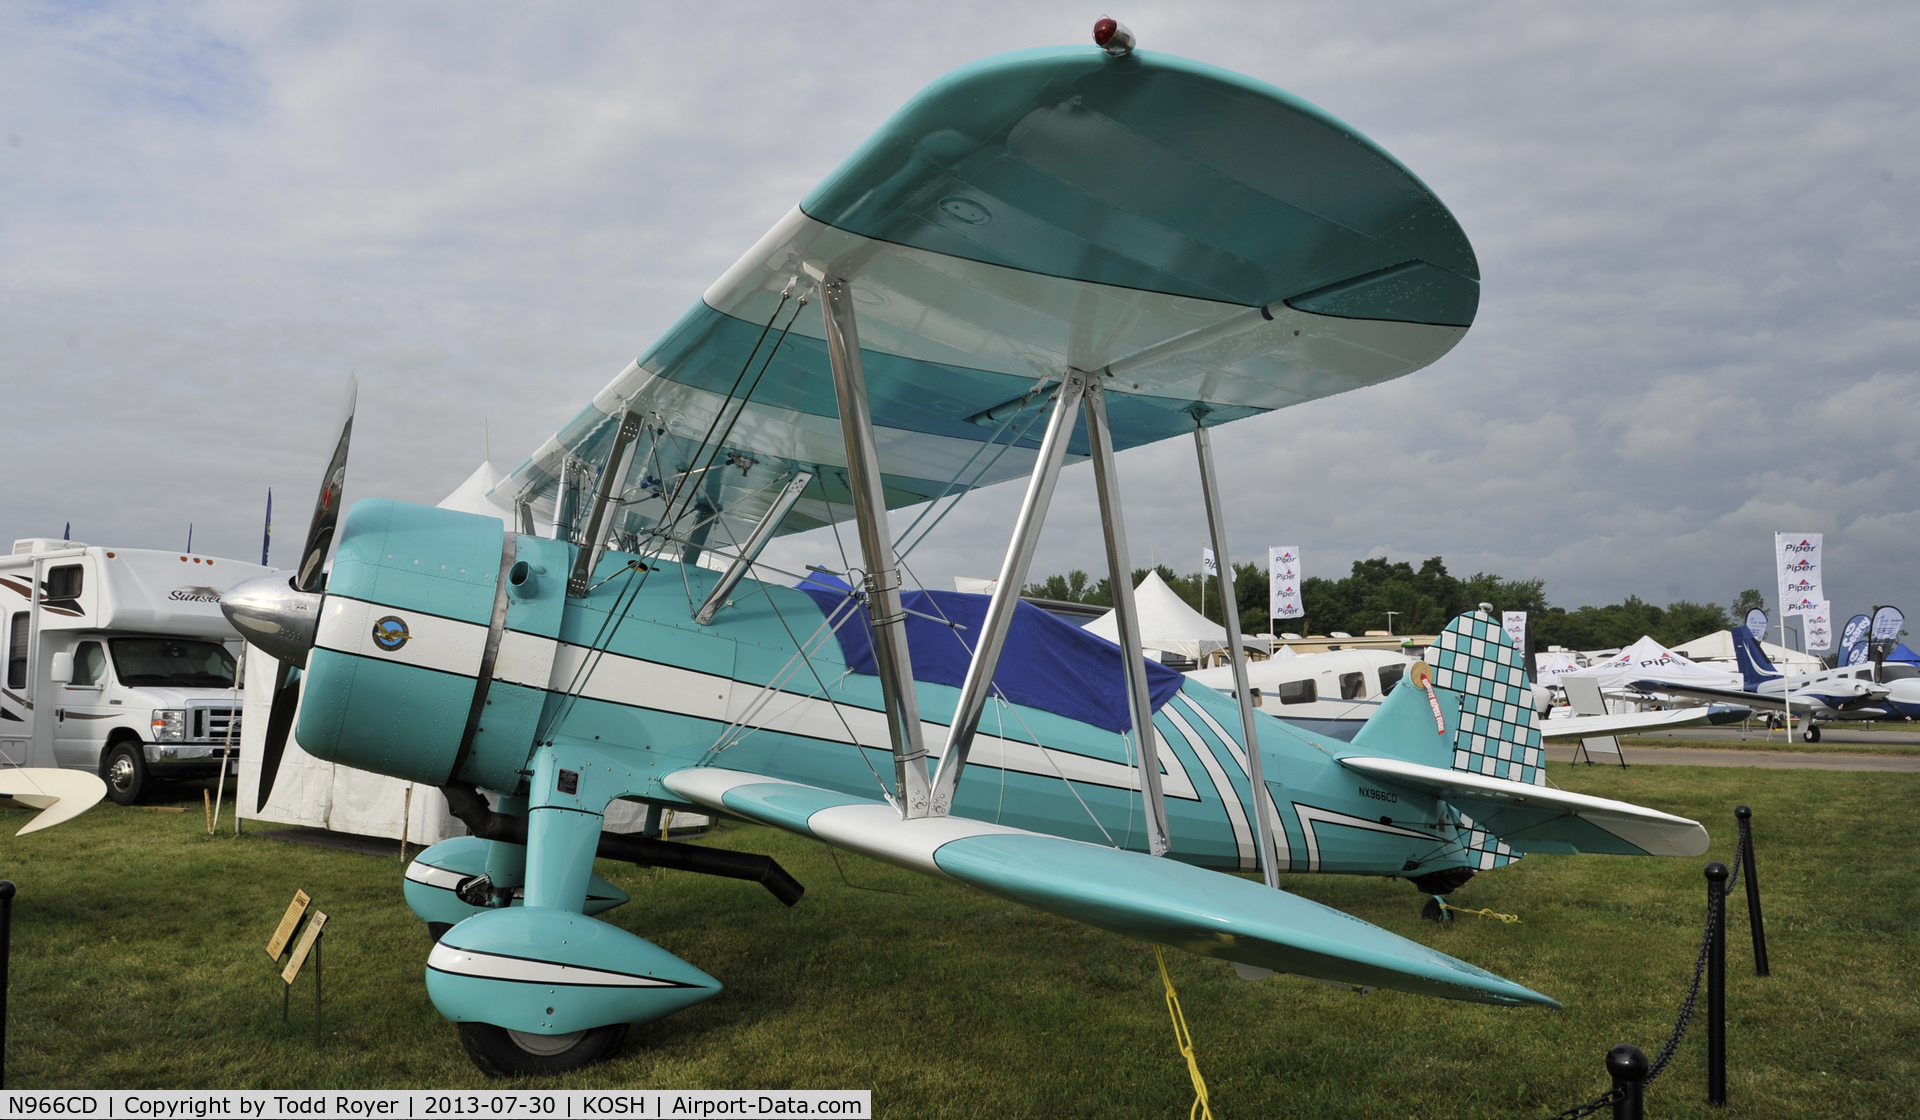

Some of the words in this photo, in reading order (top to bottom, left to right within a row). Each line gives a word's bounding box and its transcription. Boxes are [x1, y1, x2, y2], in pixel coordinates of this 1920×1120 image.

[1784, 544, 1816, 553] Piper
[1276, 556, 1297, 564] Piper
[1786, 563, 1816, 573] Piper
[1276, 573, 1296, 581] Piper
[1787, 583, 1816, 593] Piper
[168, 589, 221, 604] Sunse
[1277, 607, 1299, 615] Piper
[1788, 603, 1818, 611] Piper
[1842, 616, 1871, 652] Searey
[1640, 656, 1689, 668] Piper
[1358, 787, 1398, 803] NX966CD
